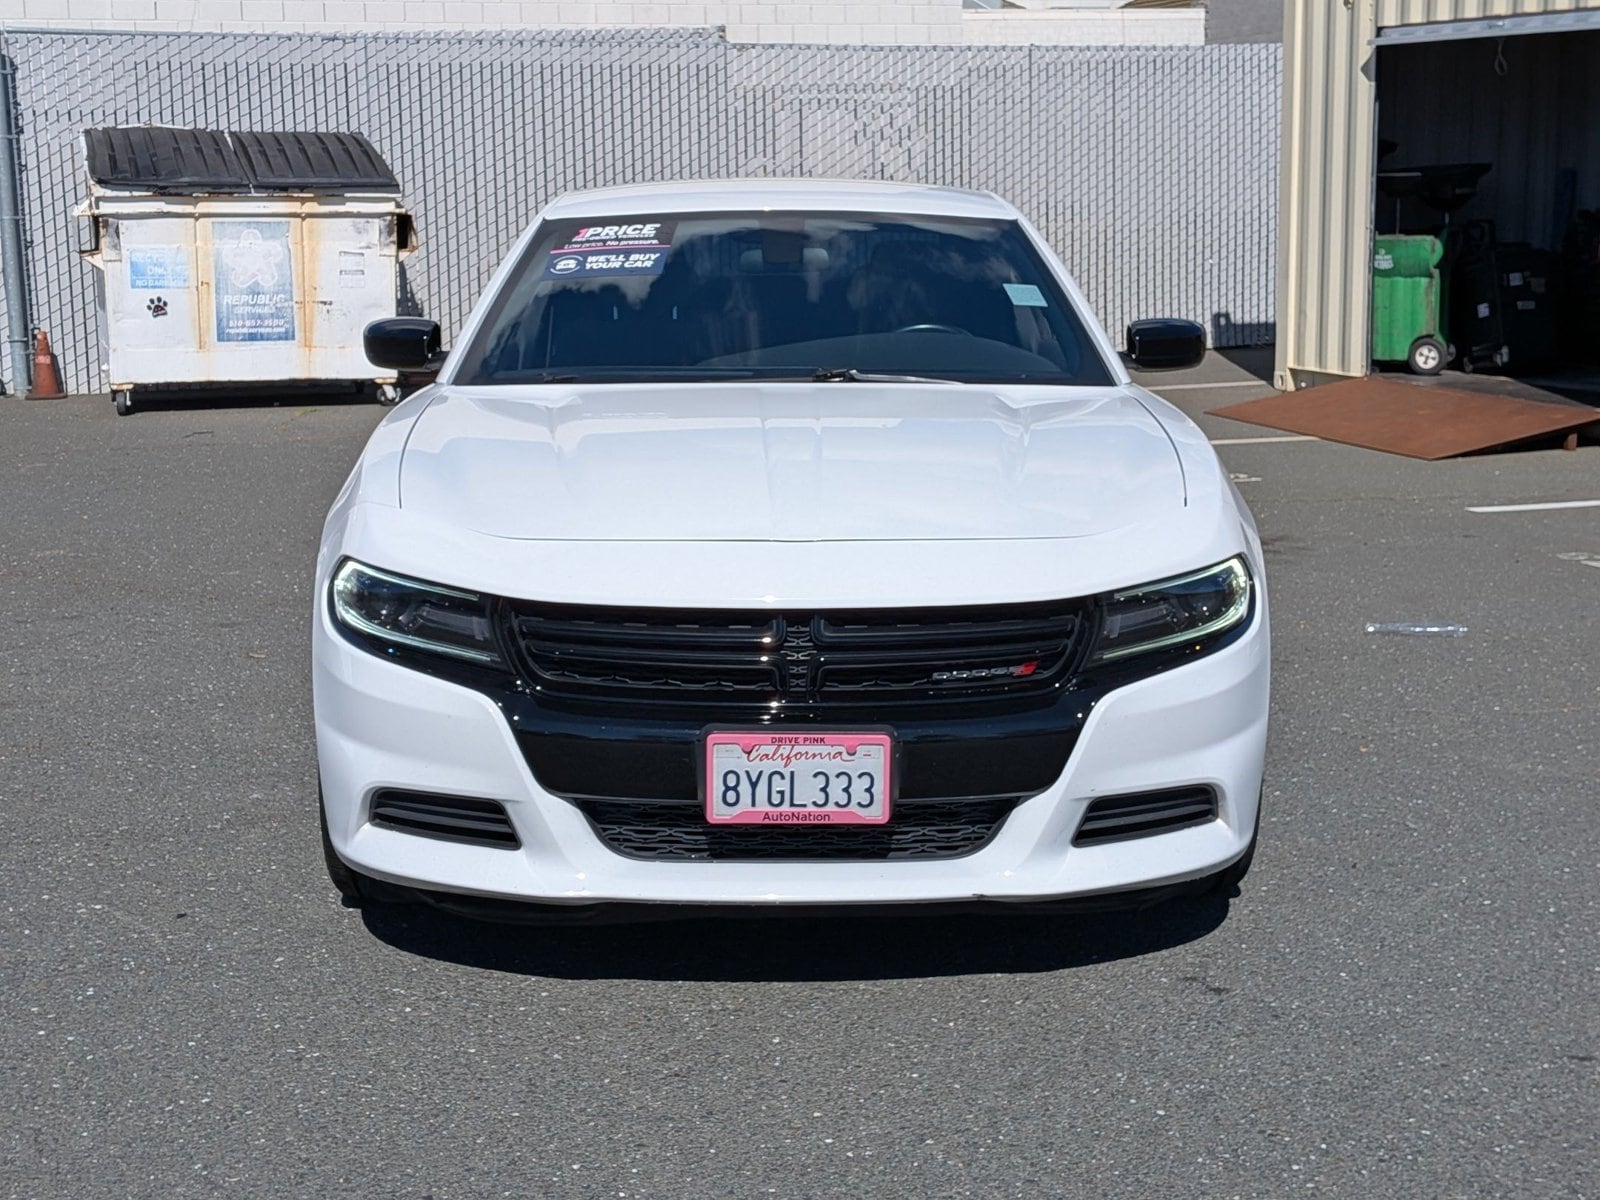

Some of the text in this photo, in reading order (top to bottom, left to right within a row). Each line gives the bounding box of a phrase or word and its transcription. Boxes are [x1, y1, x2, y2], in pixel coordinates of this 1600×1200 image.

[586, 252, 661, 262] WE'LL BUY
[585, 259, 654, 270] YOUR CAR
[223, 293, 286, 305] REPUBLIC
[234, 305, 276, 314] SERVICES
[770, 736, 826, 744] DRIVE PINK
[747, 744, 855, 768] California
[721, 769, 875, 808] 8YGL333
[761, 811, 831, 822] AutoNation
